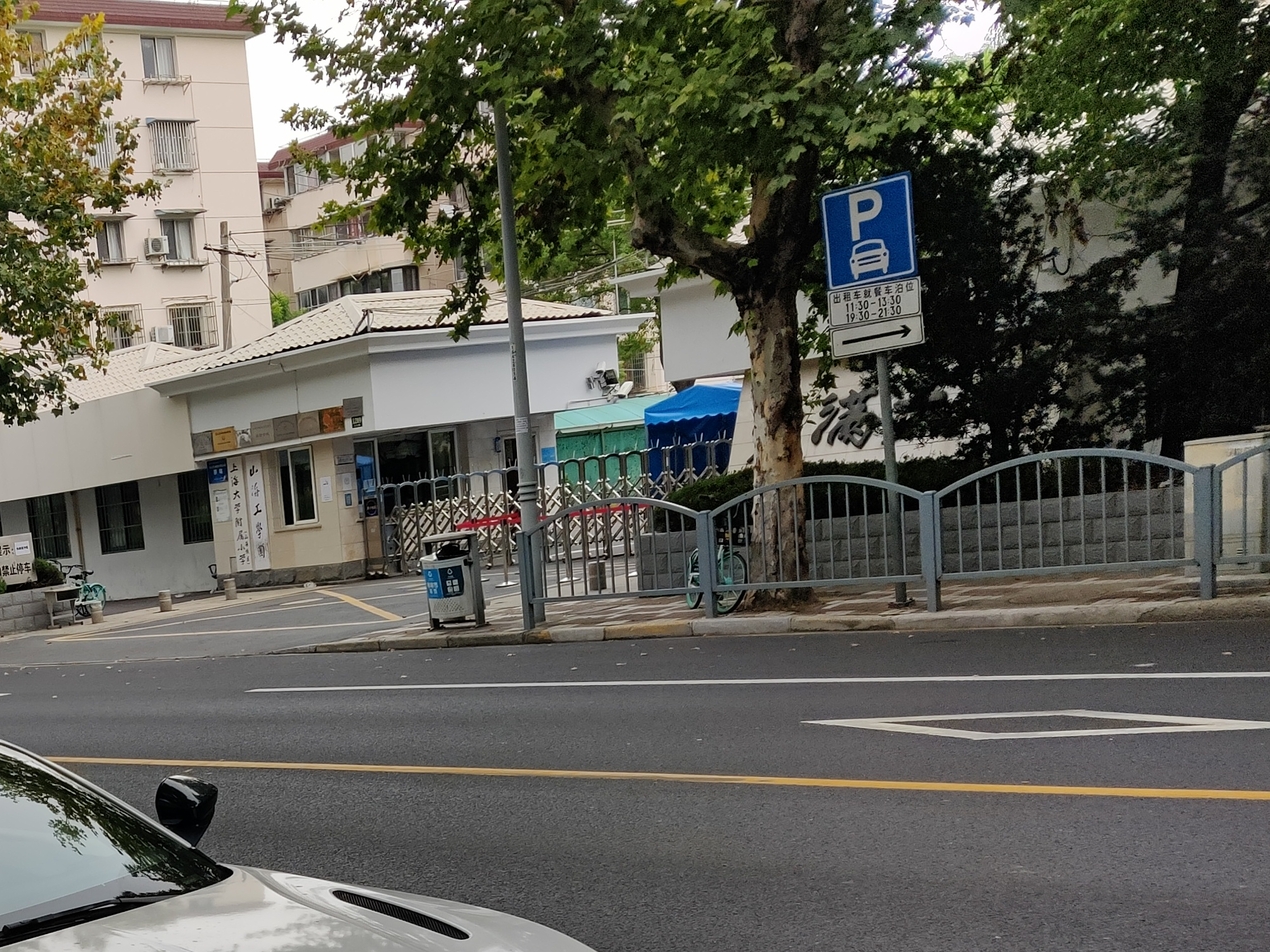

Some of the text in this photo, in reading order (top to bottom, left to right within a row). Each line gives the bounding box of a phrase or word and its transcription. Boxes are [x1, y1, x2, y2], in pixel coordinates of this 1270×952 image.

[848, 189, 883, 241] P
[833, 281, 914, 304] 出租车就餐车泊位
